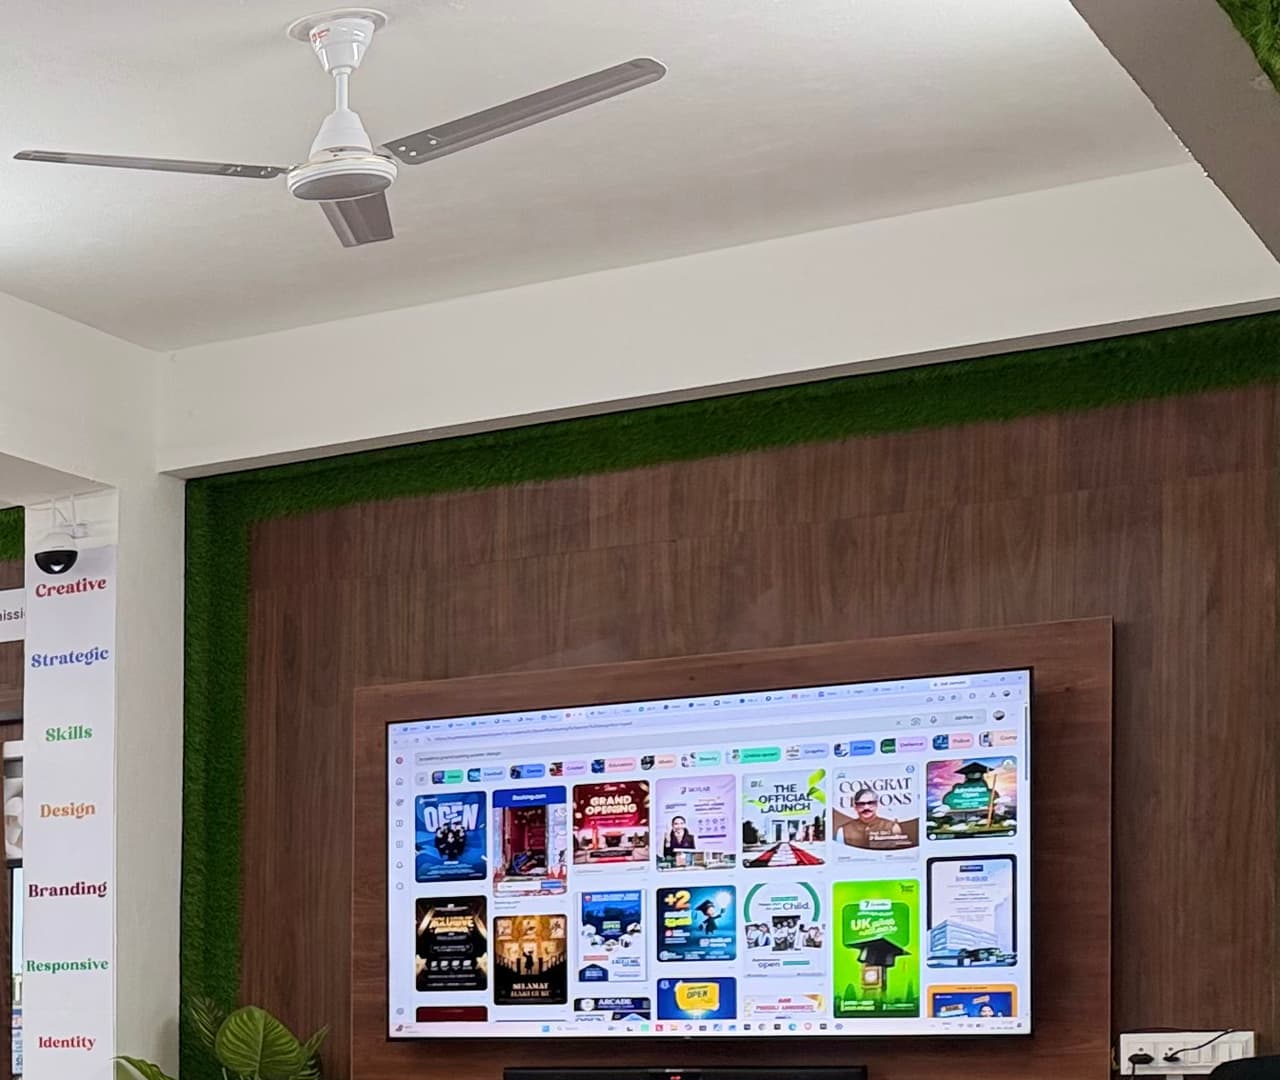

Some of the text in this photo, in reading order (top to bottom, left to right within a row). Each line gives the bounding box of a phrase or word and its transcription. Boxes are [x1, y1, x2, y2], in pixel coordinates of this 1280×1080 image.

[35, 577, 107, 598] Creative
[30, 646, 109, 669] Strategic
[45, 725, 93, 742] Skills
[774, 784, 797, 793] THE
[840, 777, 912, 793] CONGRAT
[590, 795, 632, 806] GRAND
[759, 793, 812, 804] OFFICIAL
[40, 802, 96, 820] Design
[585, 804, 637, 815] OPENING
[761, 803, 811, 813] LAUNCH
[423, 804, 479, 832] OPEN
[28, 880, 107, 898] Branding
[664, 890, 691, 909] +2
[851, 917, 872, 931] UK
[26, 958, 109, 973] Responsive
[39, 1035, 96, 1051] Identity
